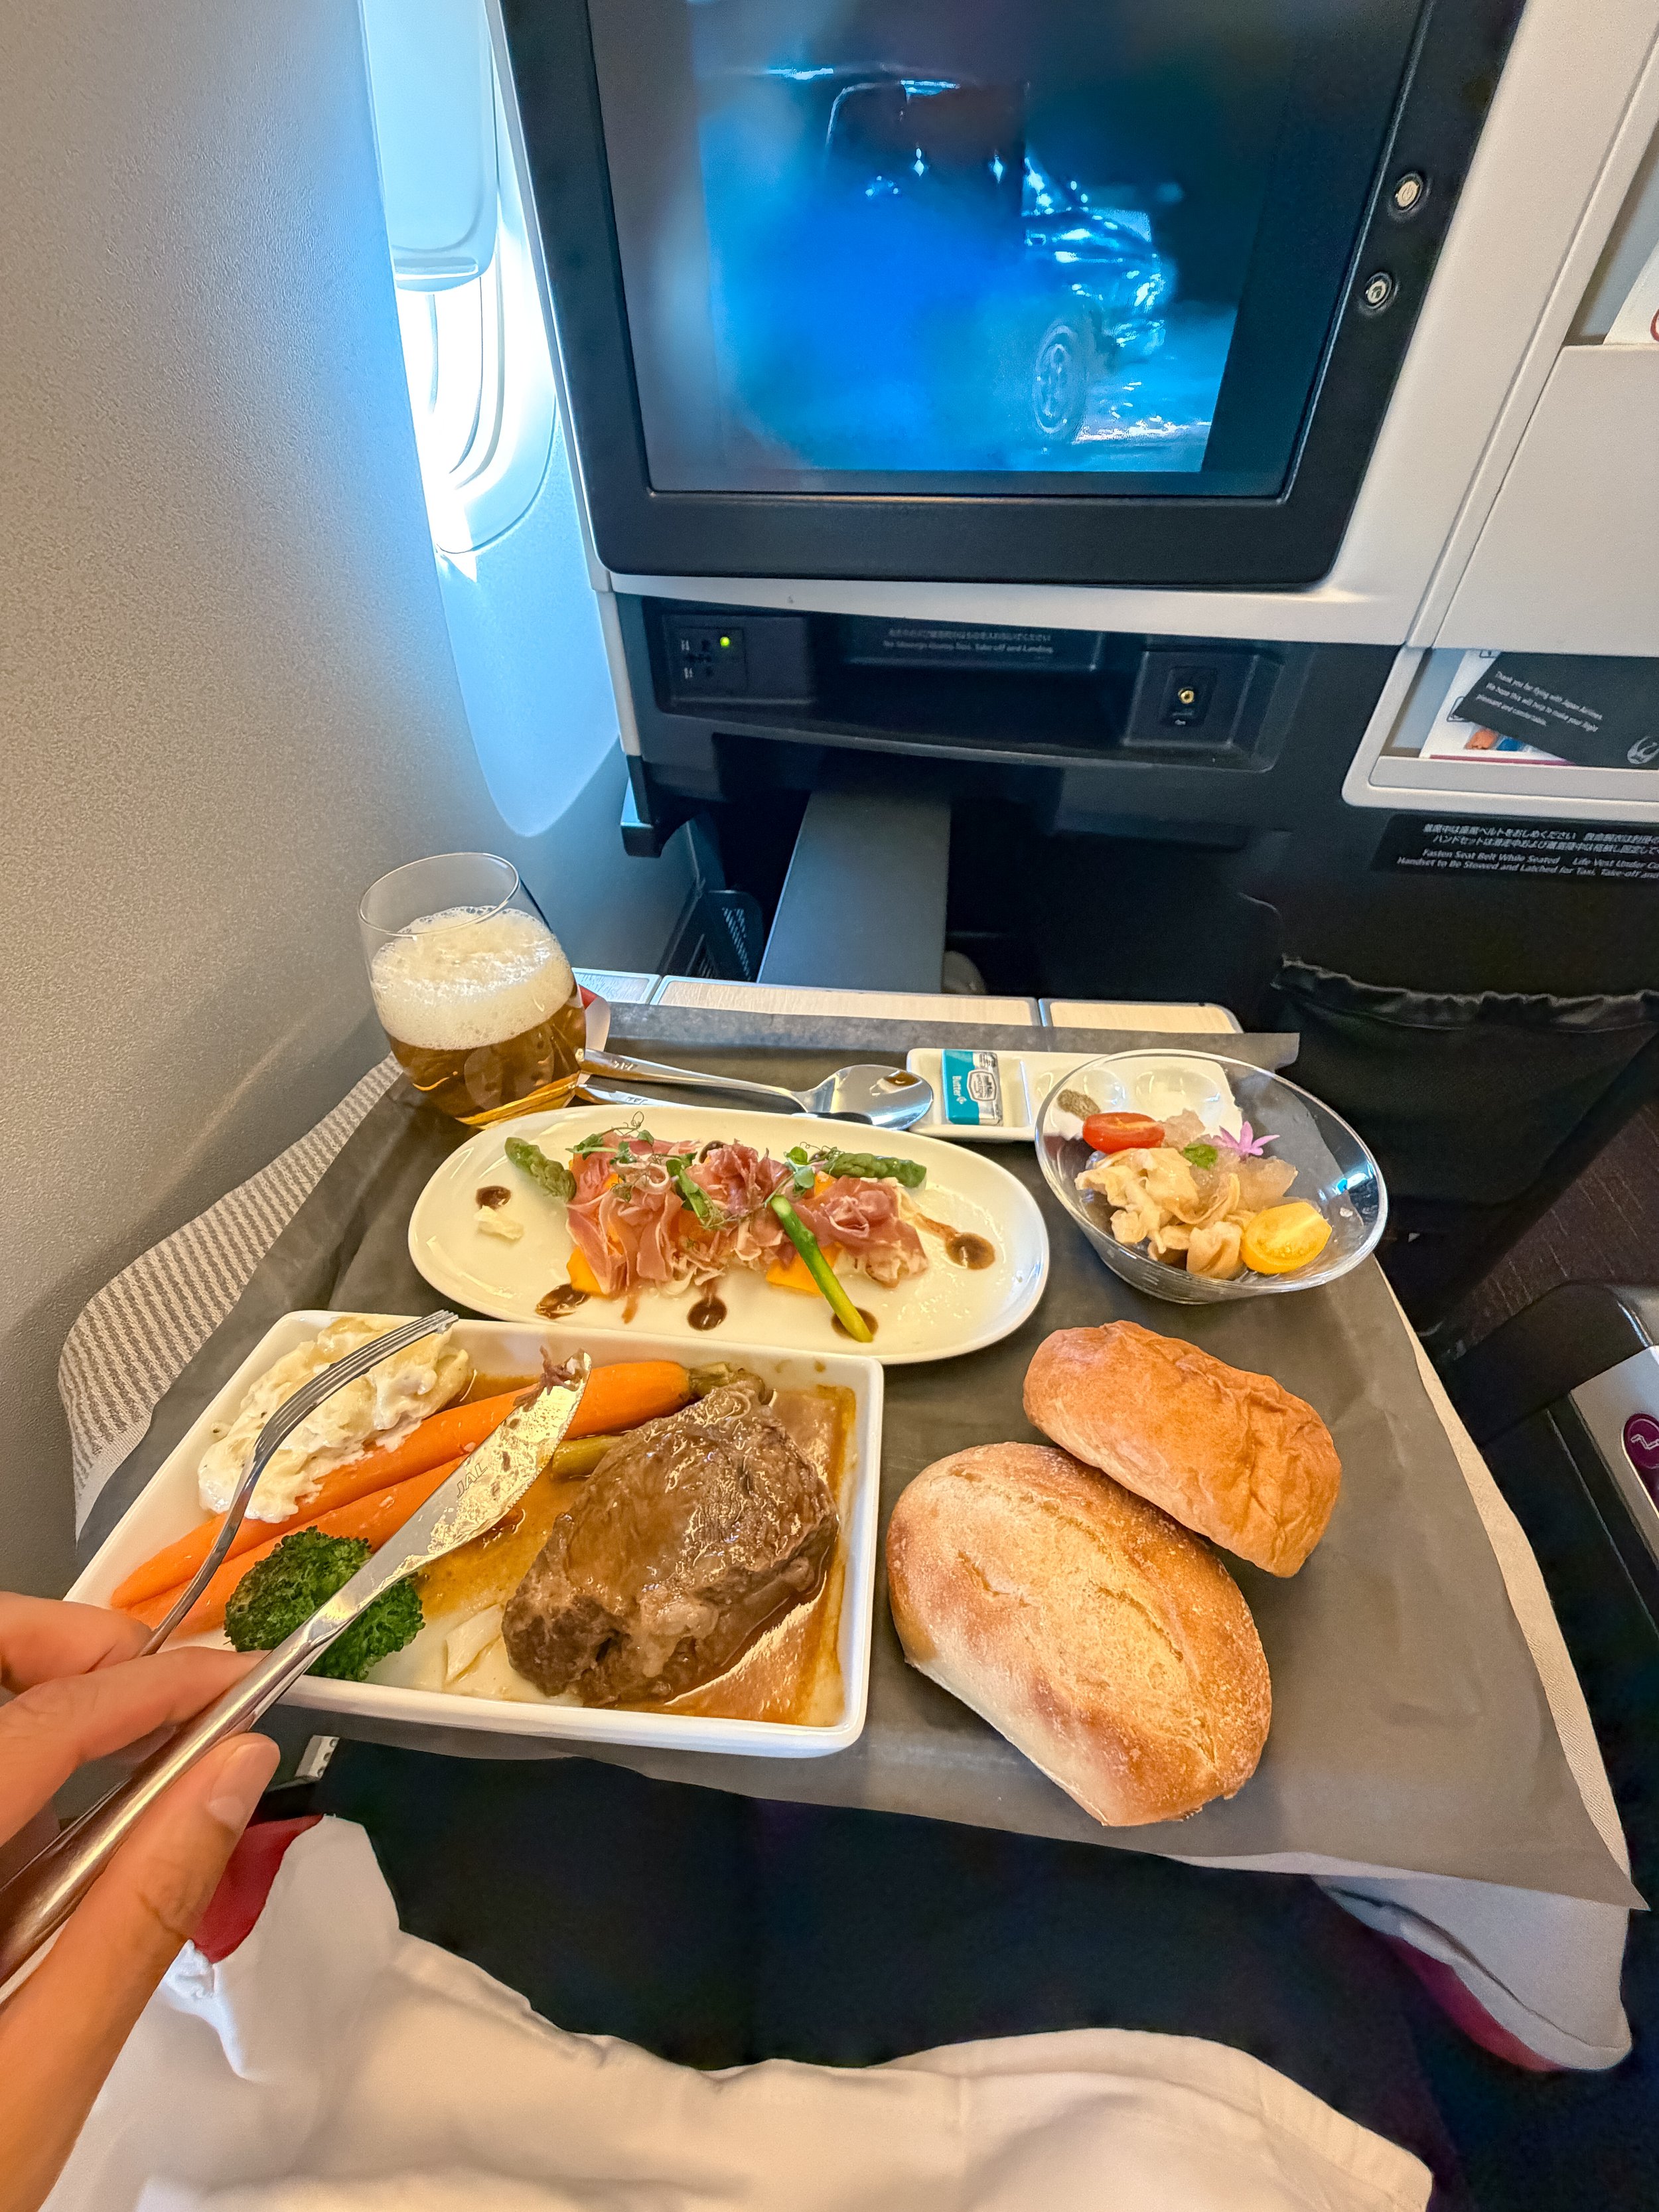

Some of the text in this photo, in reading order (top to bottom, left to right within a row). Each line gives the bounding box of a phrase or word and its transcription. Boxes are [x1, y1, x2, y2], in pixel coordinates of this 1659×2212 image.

[1495, 671, 1513, 684] Thank
[1523, 682, 1533, 691] for
[1533, 687, 1550, 700] flying
[1486, 682, 1496, 691] We
[1495, 686, 1510, 697] hope
[1510, 692, 1522, 701] this
[1522, 698, 1534, 706] will
[1532, 701, 1546, 712] help
[1552, 710, 1569, 721] make
[1567, 717, 1583, 725] your
[1396, 856, 1436, 867] Handset
[1449, 859, 1462, 869] Be
[1463, 861, 1500, 870] Stowed
[1499, 863, 1520, 871] and
[1520, 863, 1559, 873] Latched
[1559, 865, 1575, 874] for
[1601, 867, 1642, 877] Take-off
[1422, 848, 1453, 858] Fasten
[1454, 850, 1476, 859] Seat
[1477, 852, 1496, 861] Belt
[1498, 853, 1526, 862] While
[1527, 855, 1561, 864] Seated
[1572, 857, 1592, 865] Life
[1594, 857, 1615, 867] Vest
[1616, 859, 1647, 868] Under
[952, 1076, 962, 1097] Butter
[457, 1462, 488, 1499] JAL
